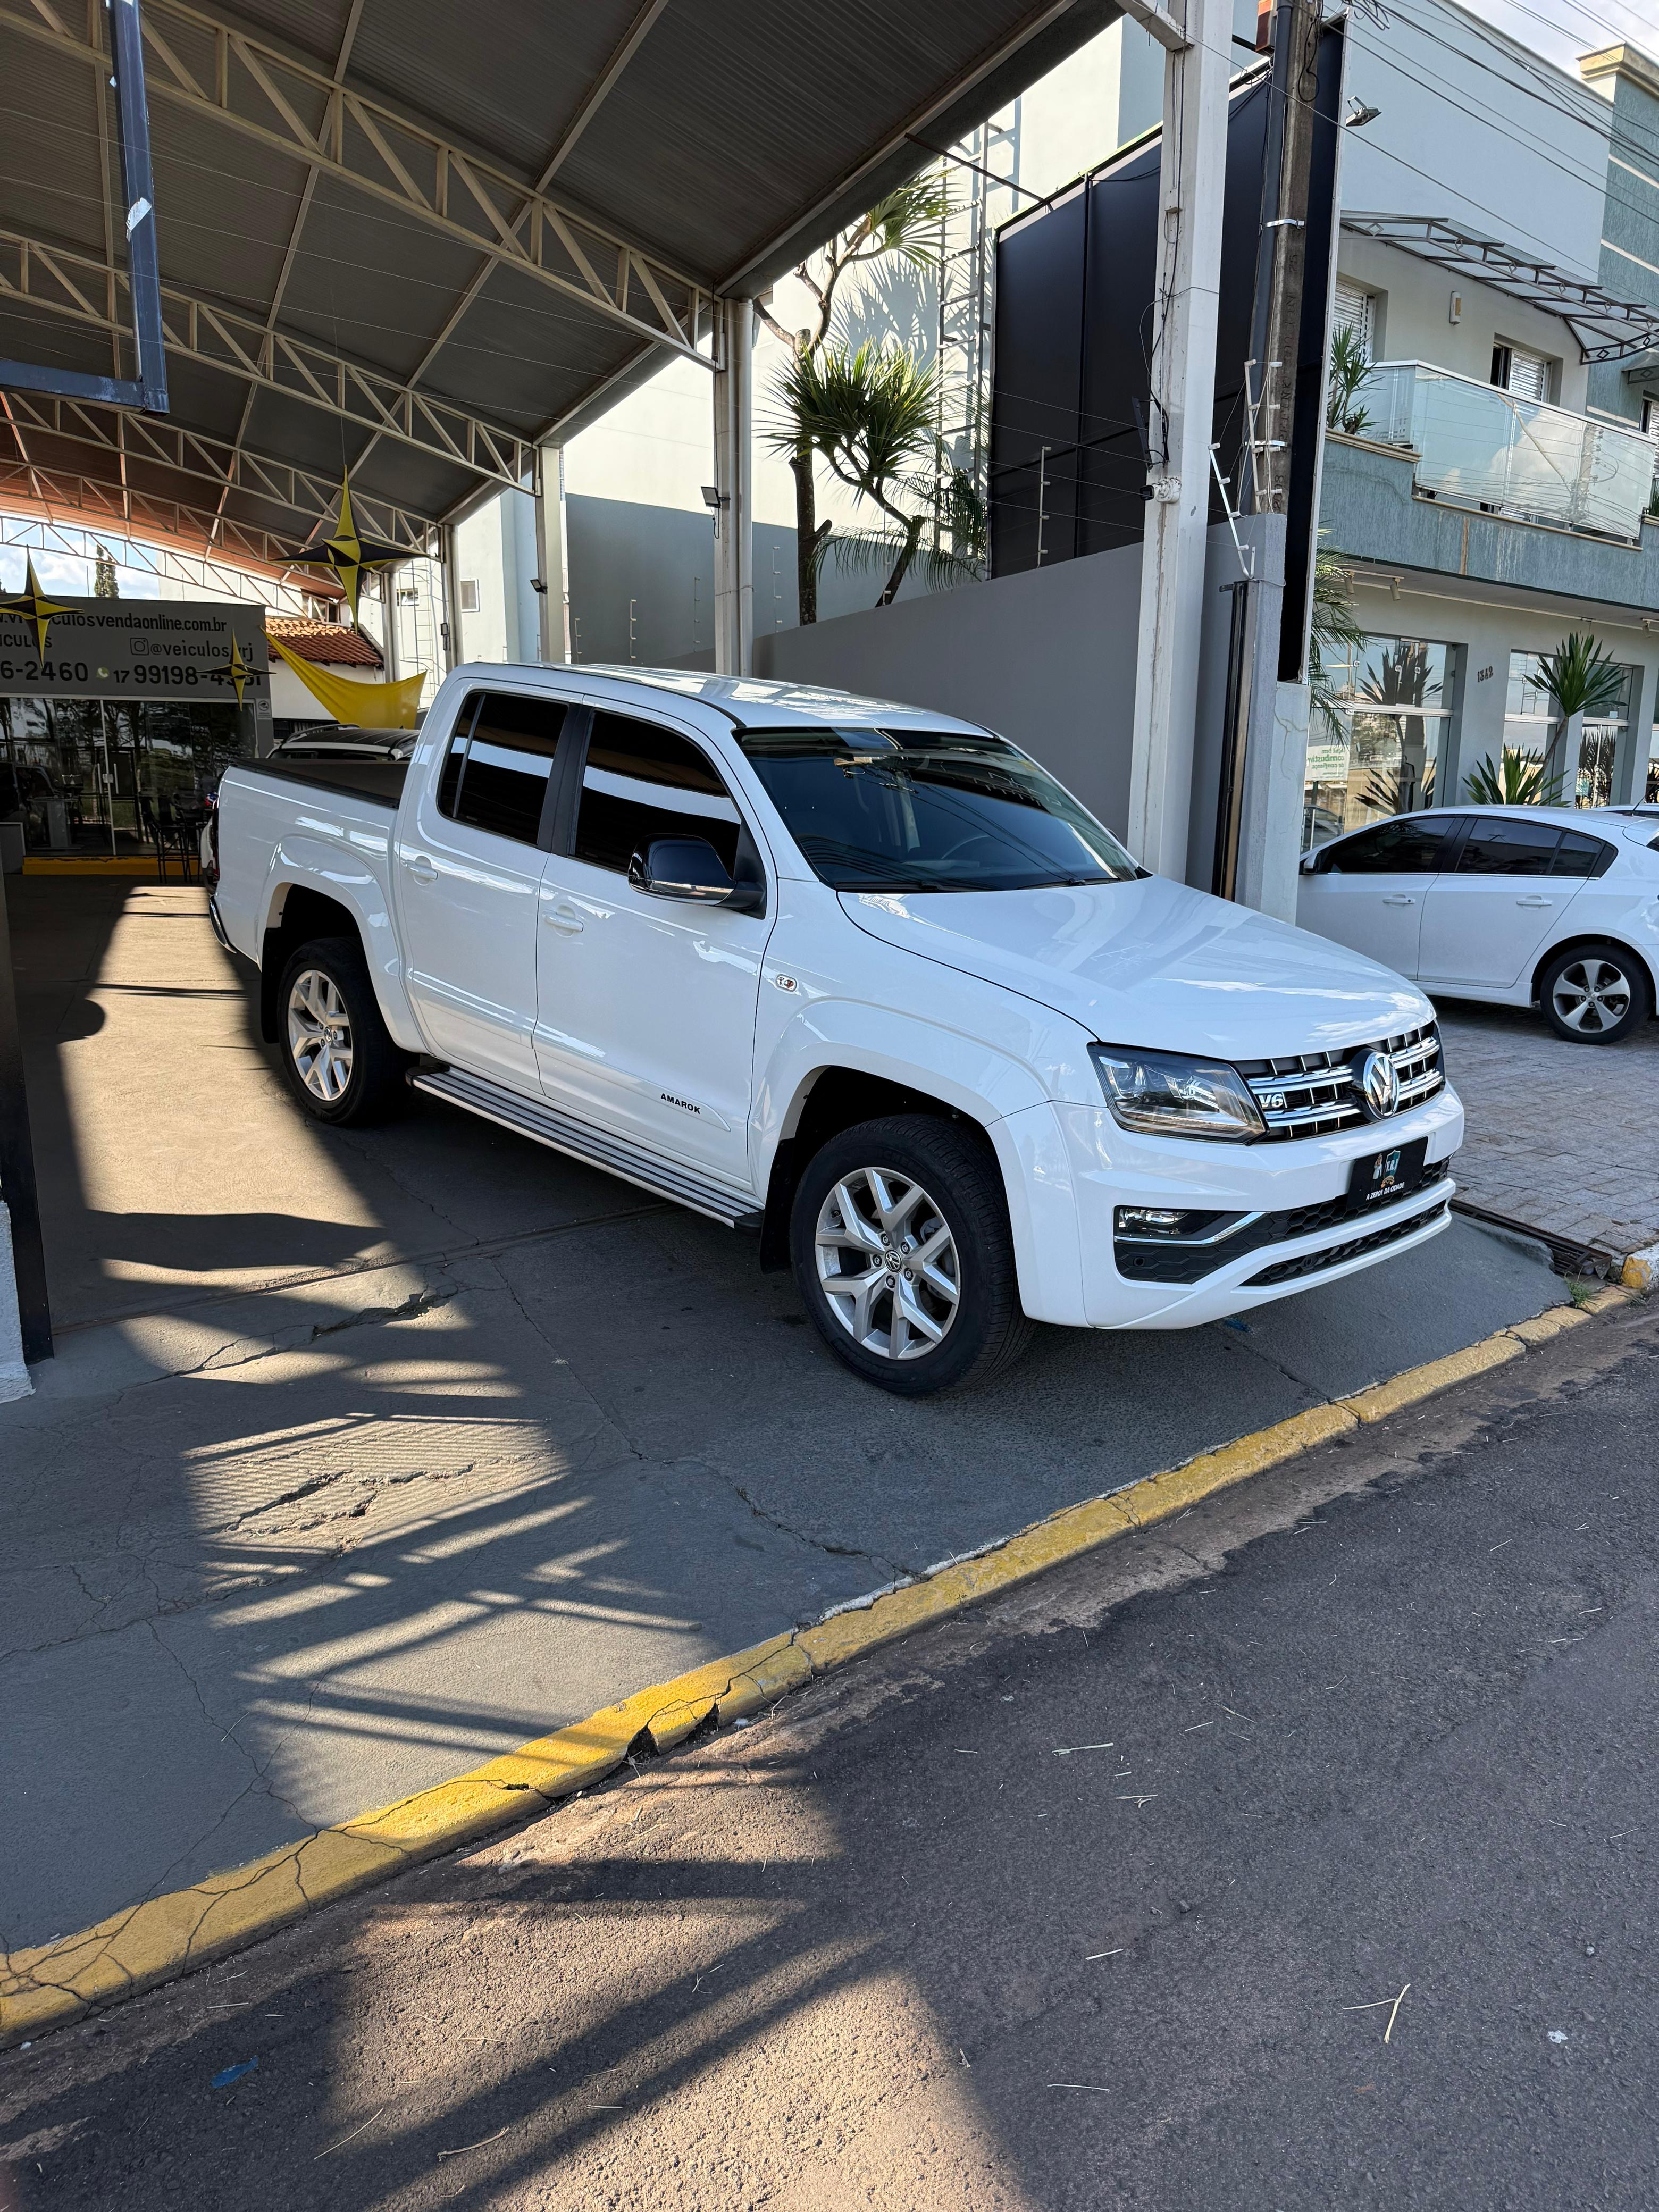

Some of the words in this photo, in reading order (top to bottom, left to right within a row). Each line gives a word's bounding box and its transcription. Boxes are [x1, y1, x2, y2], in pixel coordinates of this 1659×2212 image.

[113, 669, 130, 683] 17
[660, 1093, 701, 1115] AMAROK
[1259, 1094, 1284, 1108] V6
[1390, 1182, 1404, 1192] CIDADE
